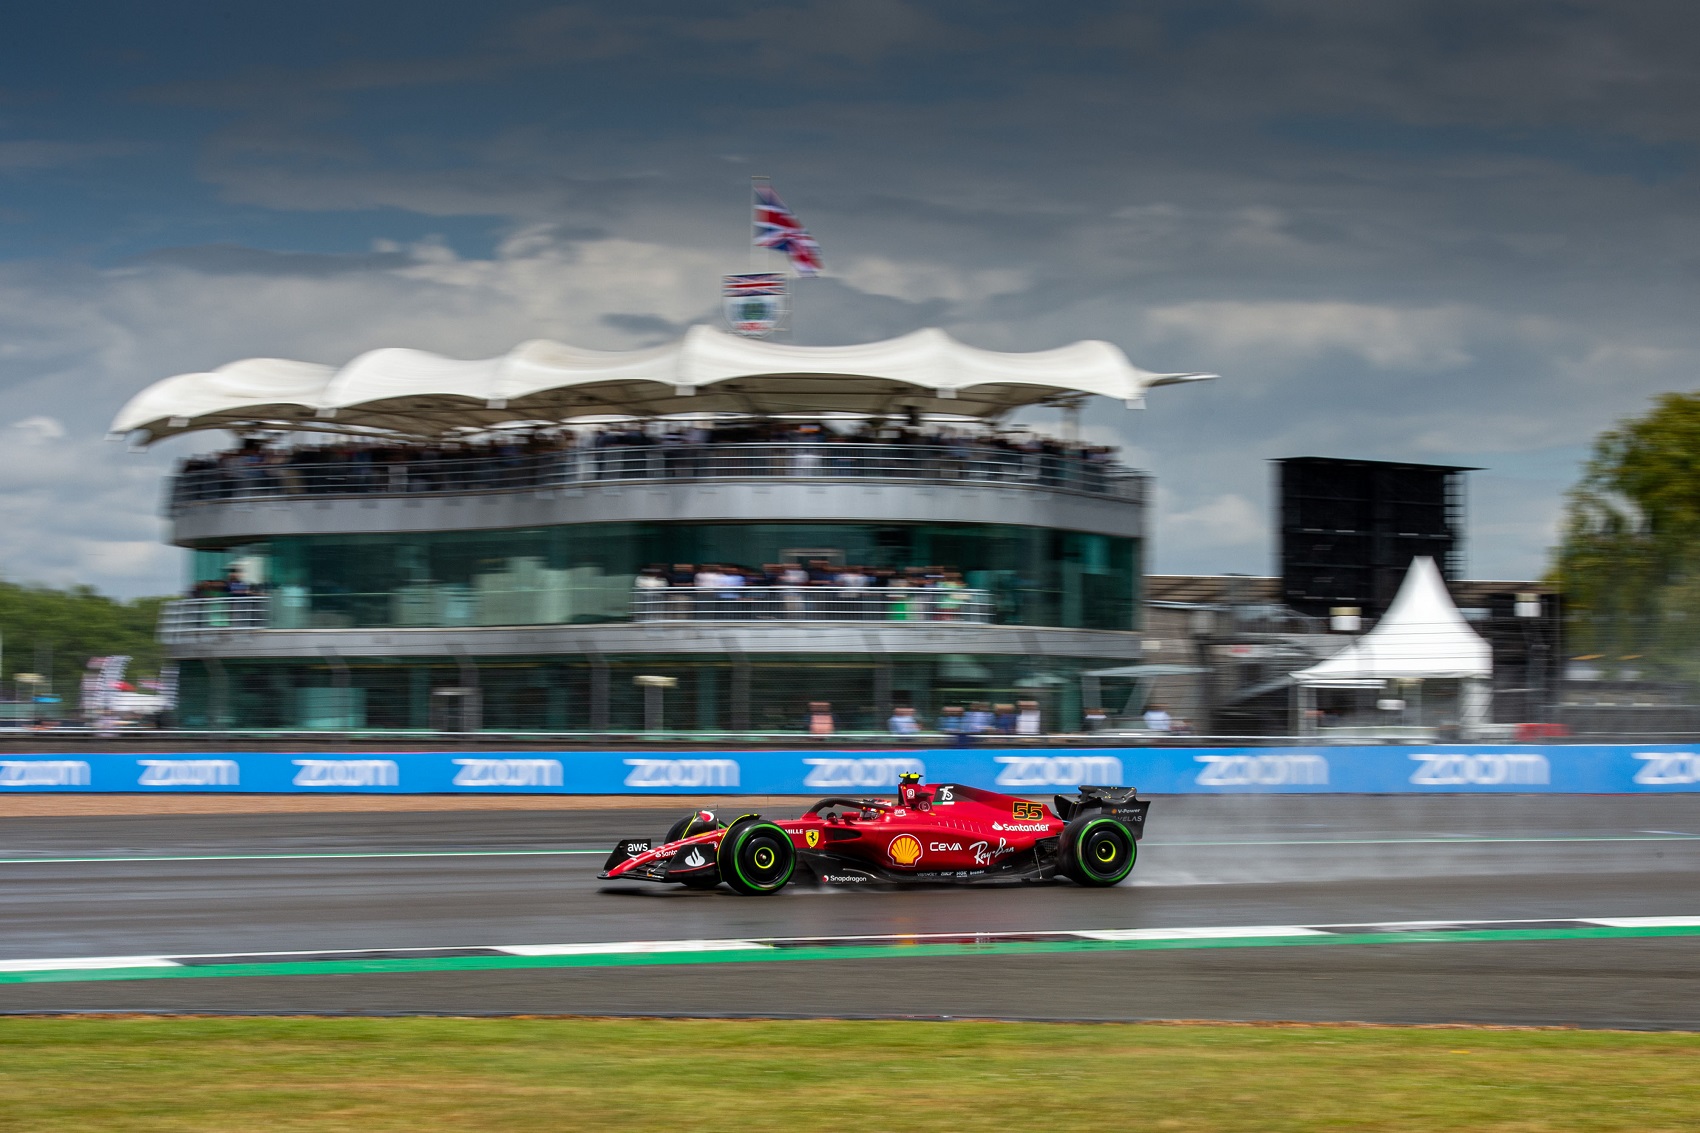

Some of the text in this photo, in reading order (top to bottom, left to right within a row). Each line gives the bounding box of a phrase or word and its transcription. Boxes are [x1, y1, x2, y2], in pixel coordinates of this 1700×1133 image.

[136, 760, 240, 785] zoom
[291, 760, 398, 786] zoom
[452, 759, 564, 786] zoom
[623, 759, 740, 786] zoom
[802, 758, 925, 787] zoom
[994, 756, 1123, 785] zoom
[1193, 755, 1329, 785] zoom
[1407, 754, 1549, 785] zoom
[1013, 801, 1043, 820] 55
[1003, 823, 1050, 832] Santander
[627, 843, 649, 852] aws
[969, 837, 1015, 866] Ray-Ban
[829, 875, 867, 883] Snapdragon
